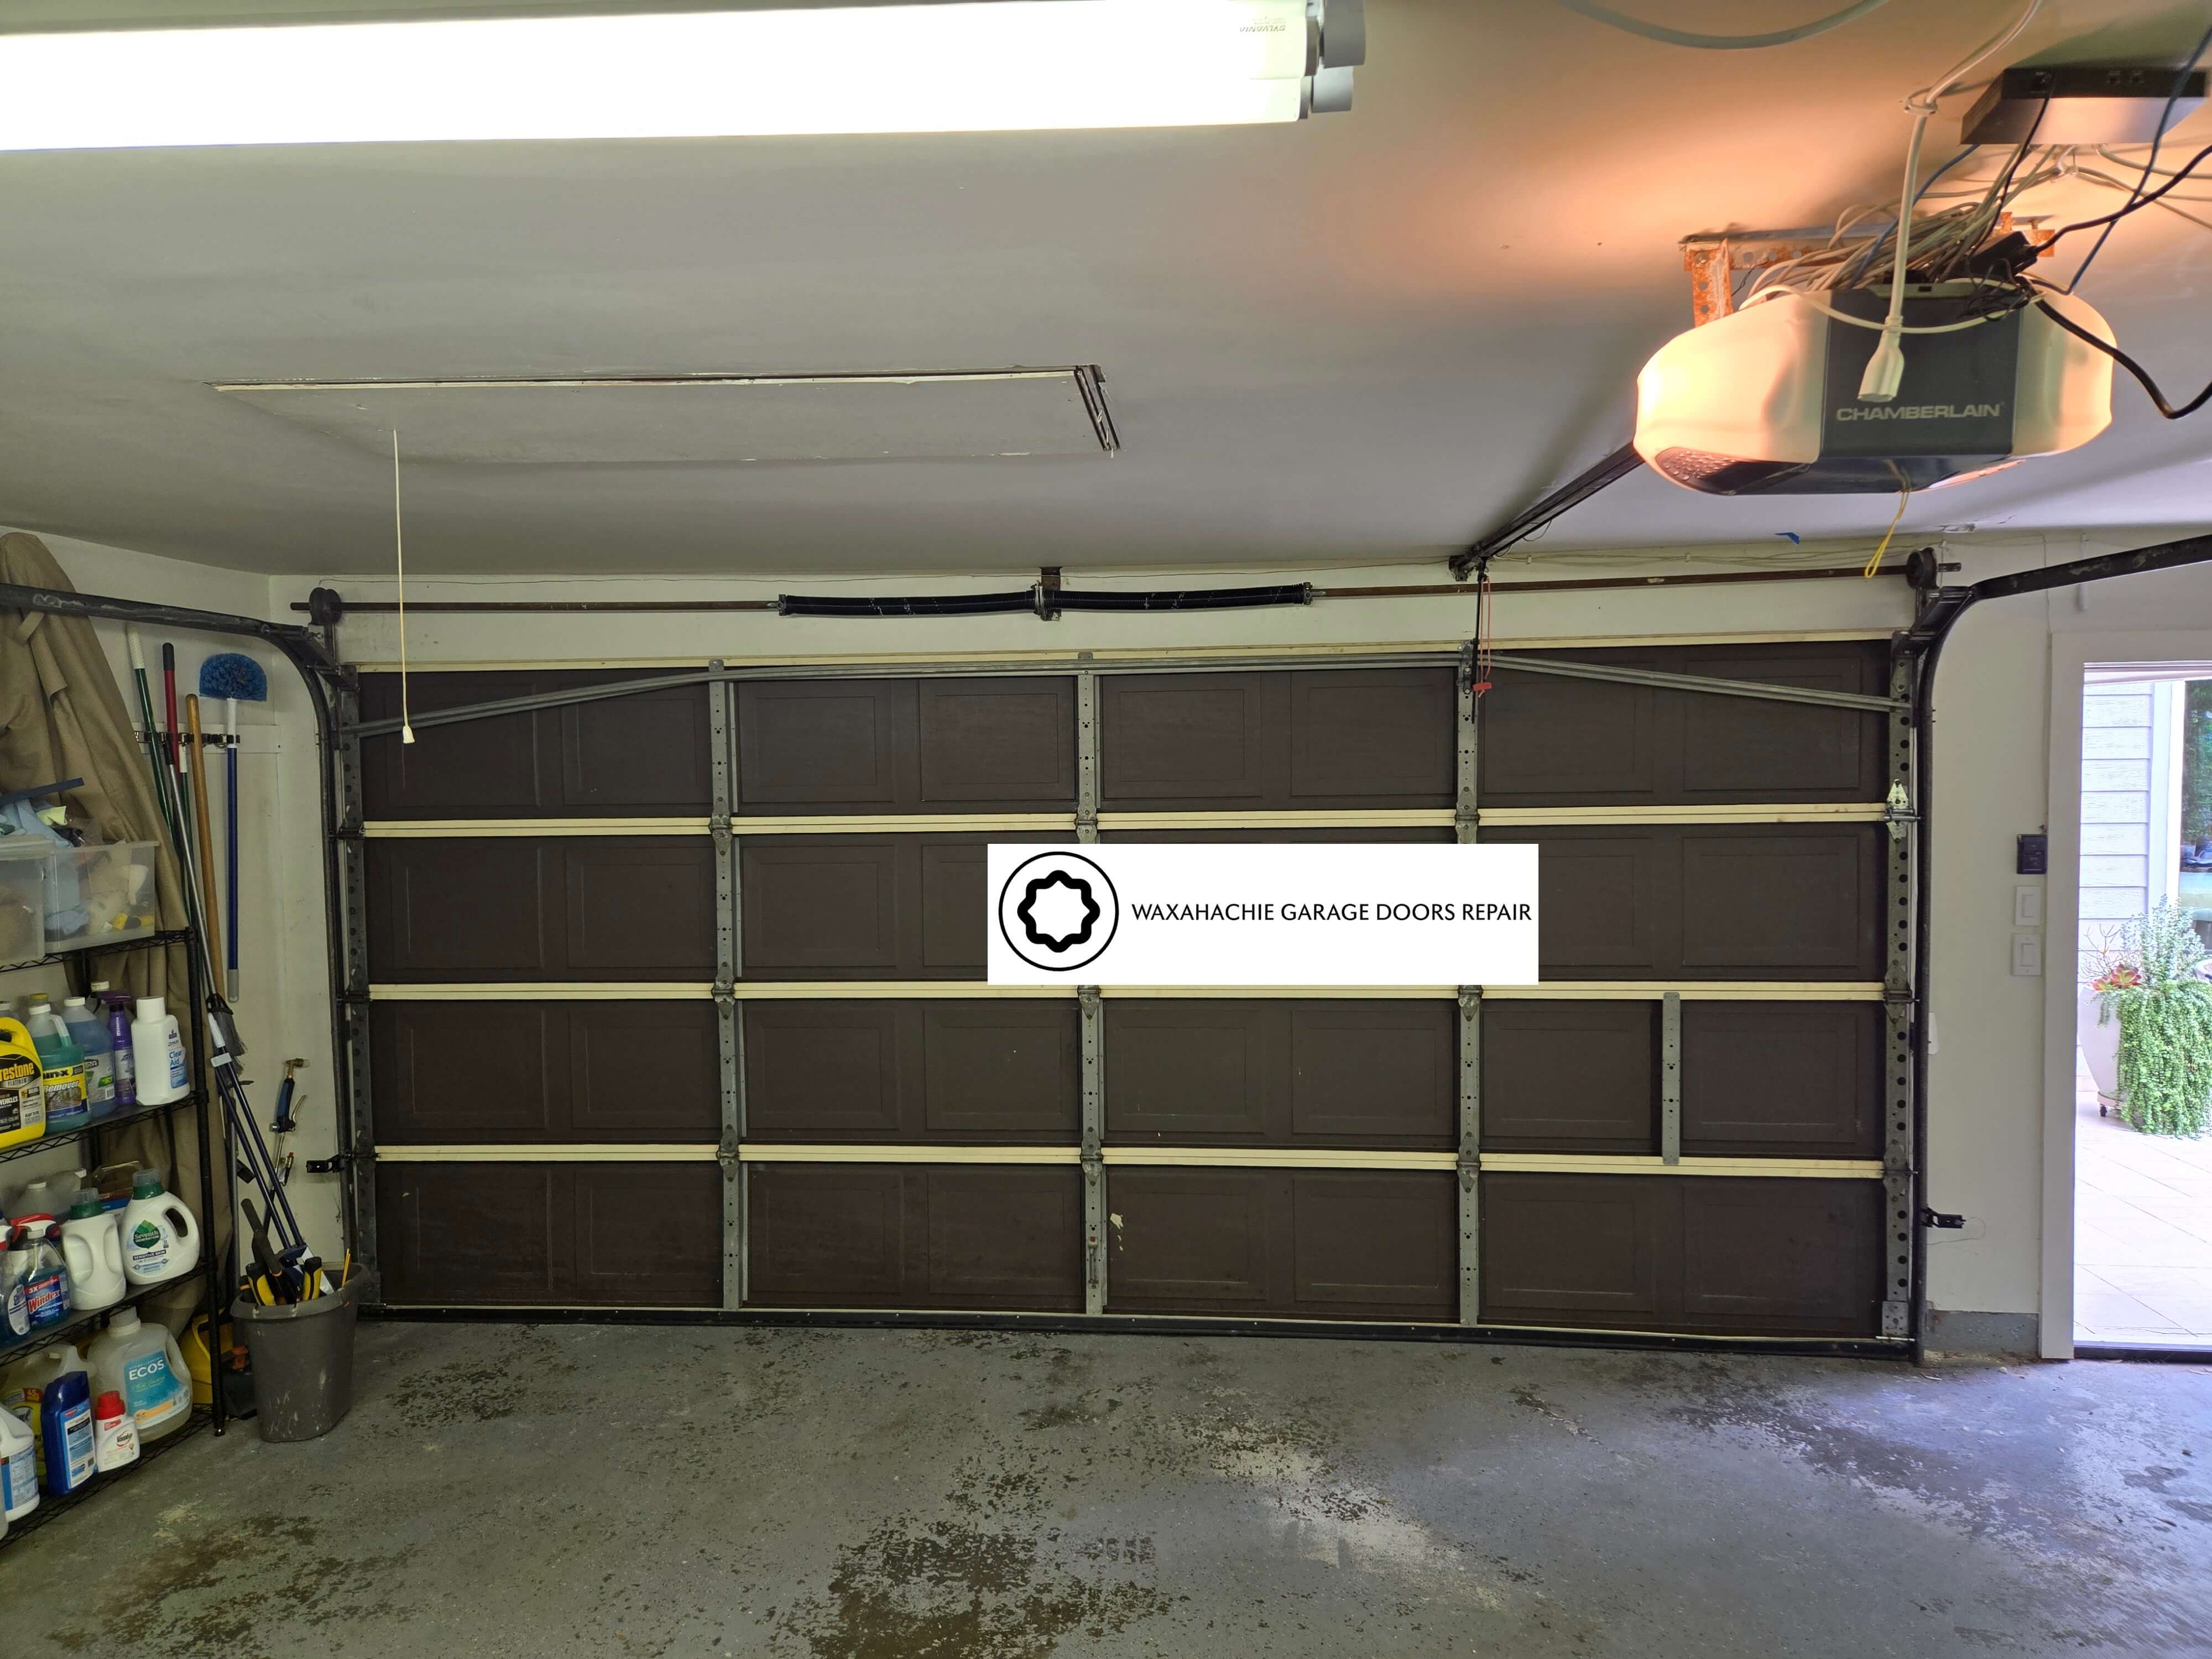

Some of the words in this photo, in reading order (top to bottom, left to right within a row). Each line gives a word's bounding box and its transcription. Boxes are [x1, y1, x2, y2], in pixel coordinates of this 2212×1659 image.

[1239, 24, 1286, 33] SYLVANIA
[1836, 403, 2000, 421] CHAMBERLAIN
[169, 1050, 182, 1059] Clear
[170, 1057, 180, 1067] Aid
[134, 1230, 159, 1240] Seventh
[28, 1290, 60, 1314] Windex
[129, 1359, 164, 1381] ECOS
